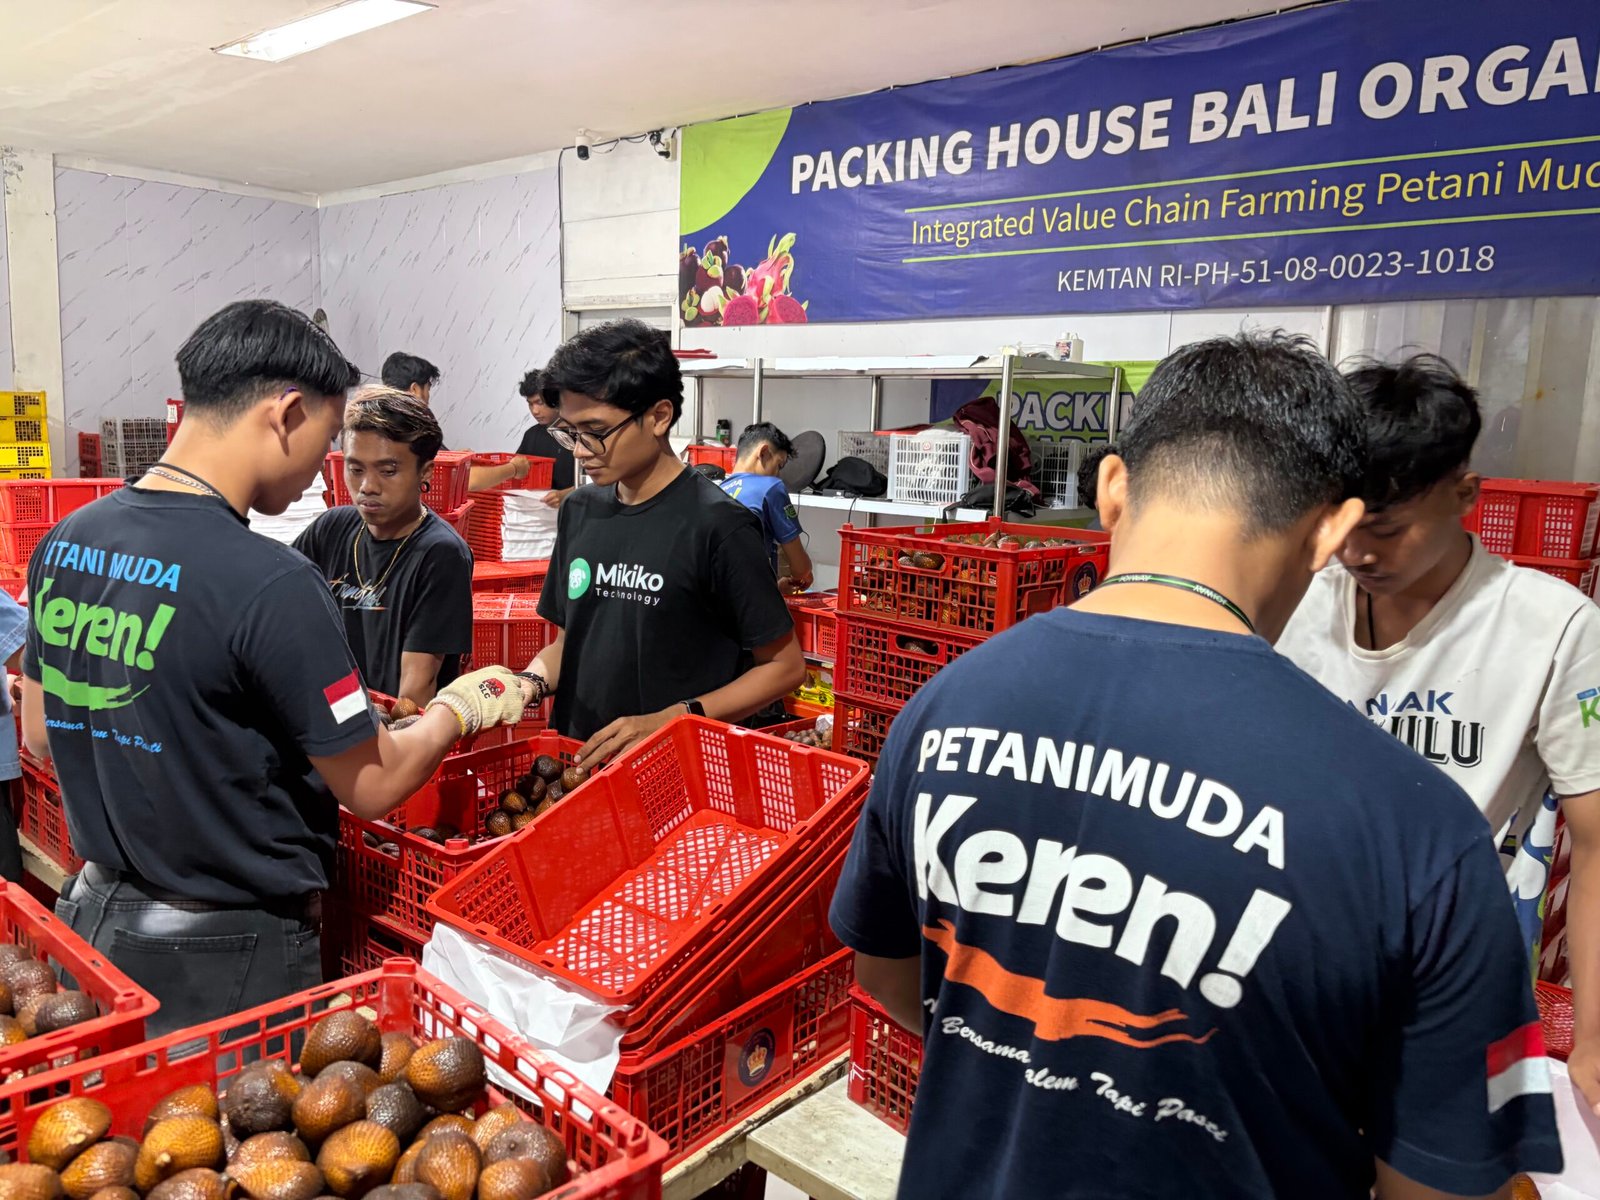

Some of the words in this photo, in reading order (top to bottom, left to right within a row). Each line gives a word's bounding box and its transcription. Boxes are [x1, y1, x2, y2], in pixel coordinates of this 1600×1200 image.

[791, 131, 973, 194] PACKING
[986, 99, 1173, 170] HOUSE
[1188, 71, 1338, 145] BALI
[1359, 36, 1600, 120] ORGA
[911, 207, 1036, 248] Integrated
[1042, 202, 1118, 234] Value
[1124, 193, 1210, 227] Chain
[1220, 178, 1367, 218] Farming
[1377, 161, 1503, 205] Petani
[1057, 265, 1153, 293] KEMTAN
[1159, 245, 1496, 287] RI-PH-51-08-0023-1018
[108, 553, 182, 592] MUDA
[595, 562, 664, 591] Mikiko
[595, 588, 660, 606] Technology
[917, 727, 1286, 870] PETANIMUDA
[913, 792, 1293, 1009] Keren!
[940, 1017, 1033, 1064] Bersama
[1090, 1071, 1146, 1118] Tapi
